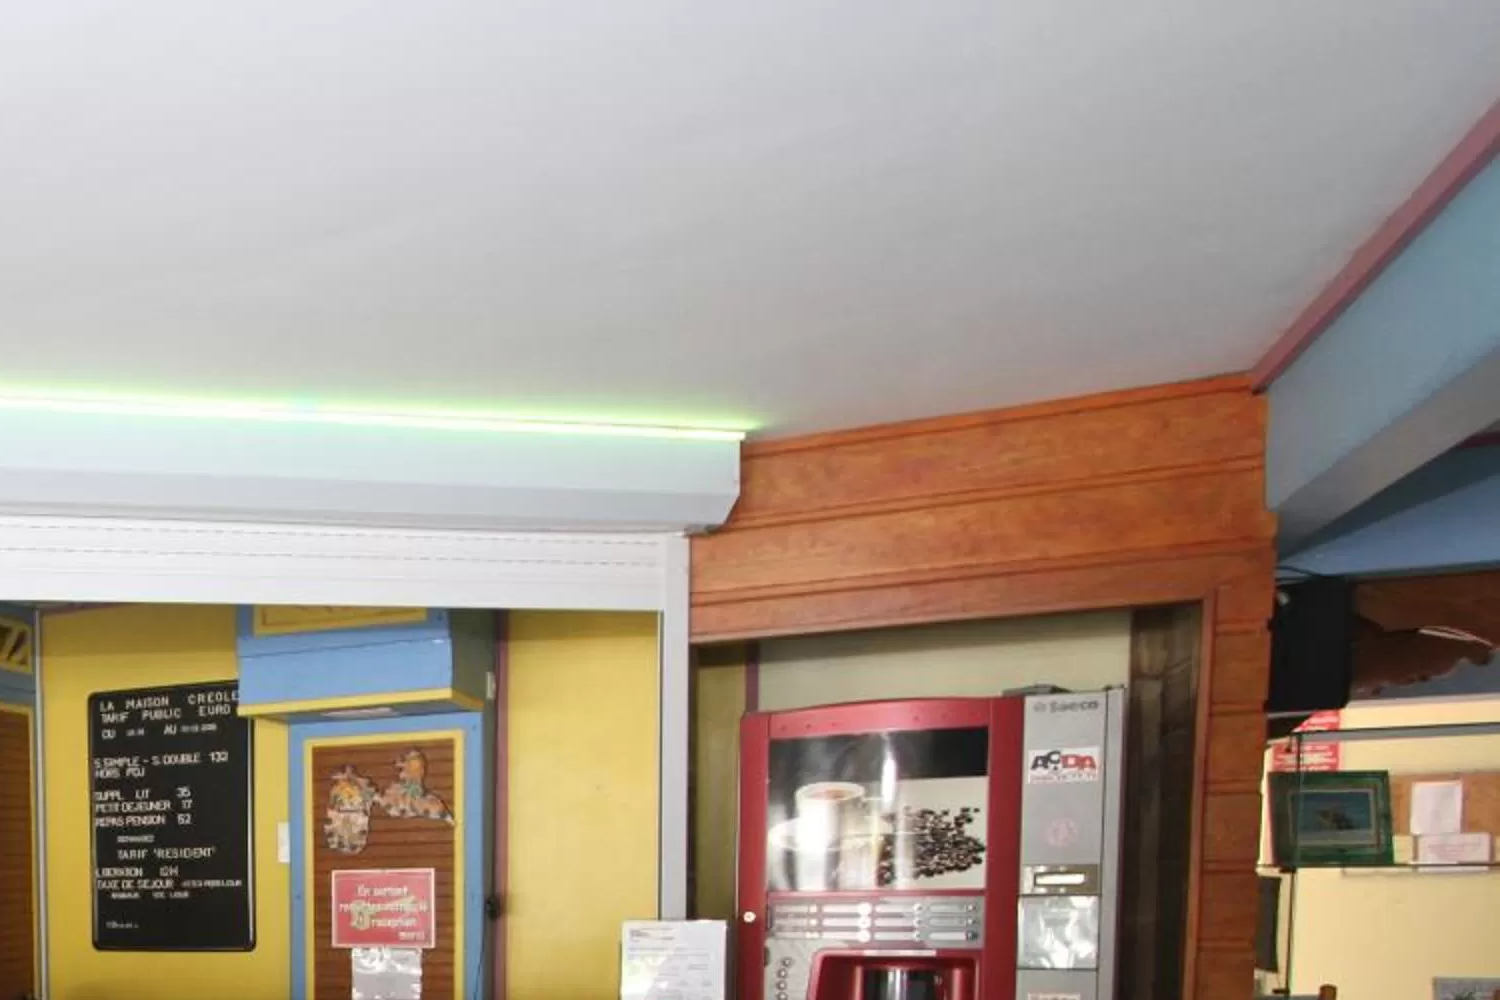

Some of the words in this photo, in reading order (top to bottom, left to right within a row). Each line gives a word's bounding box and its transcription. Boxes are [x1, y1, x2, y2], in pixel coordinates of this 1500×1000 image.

[100, 701, 114, 712] LA
[125, 696, 169, 710] MAISON
[100, 712, 129, 723] TARIF
[141, 708, 181, 720] PUBLIC
[199, 704, 231, 716] EURO
[117, 848, 148, 860] TARIF
